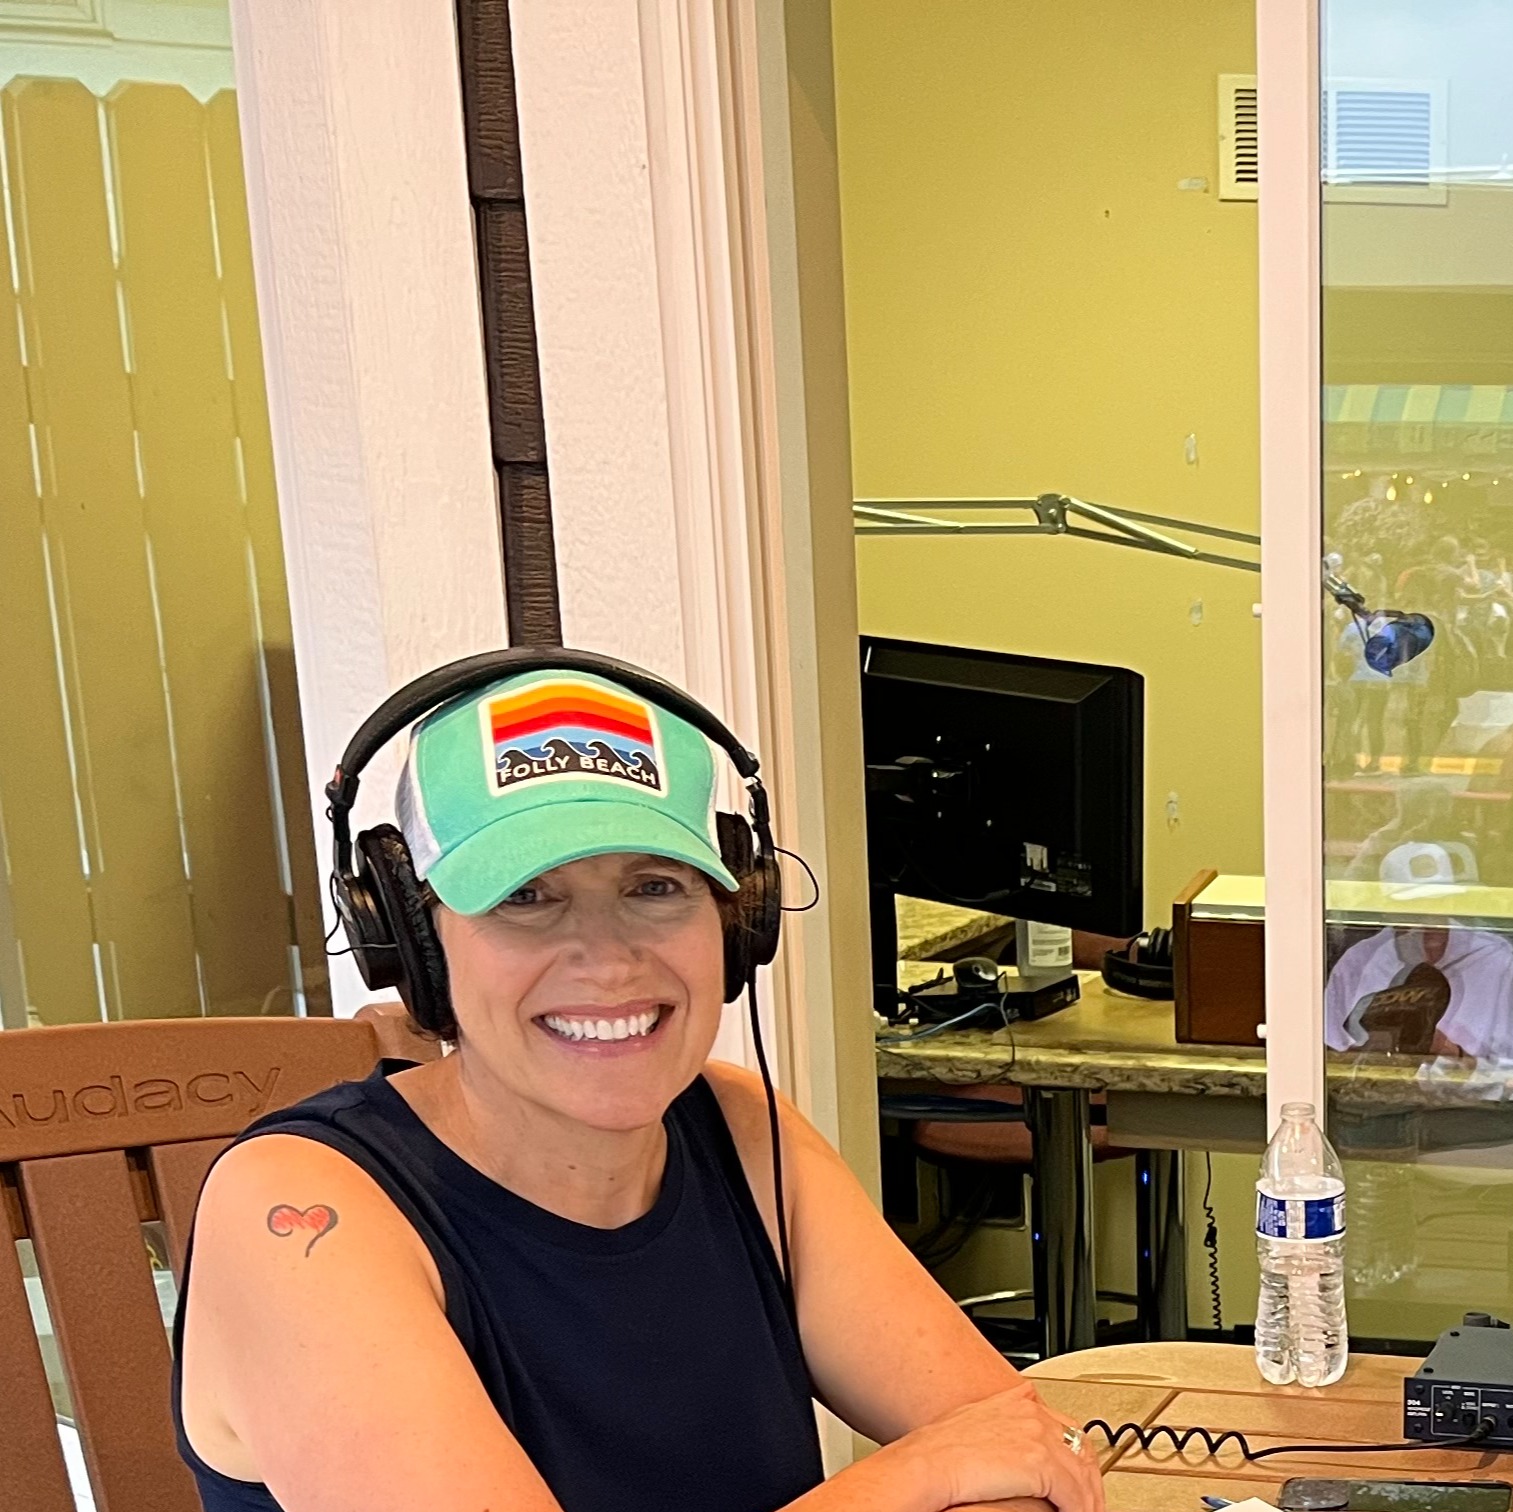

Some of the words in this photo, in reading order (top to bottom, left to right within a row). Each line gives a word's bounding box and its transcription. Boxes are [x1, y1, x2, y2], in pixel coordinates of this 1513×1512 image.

[500, 755, 570, 783] FOLLY
[579, 757, 656, 785] BEACH
[0, 1067, 281, 1128] udacy
